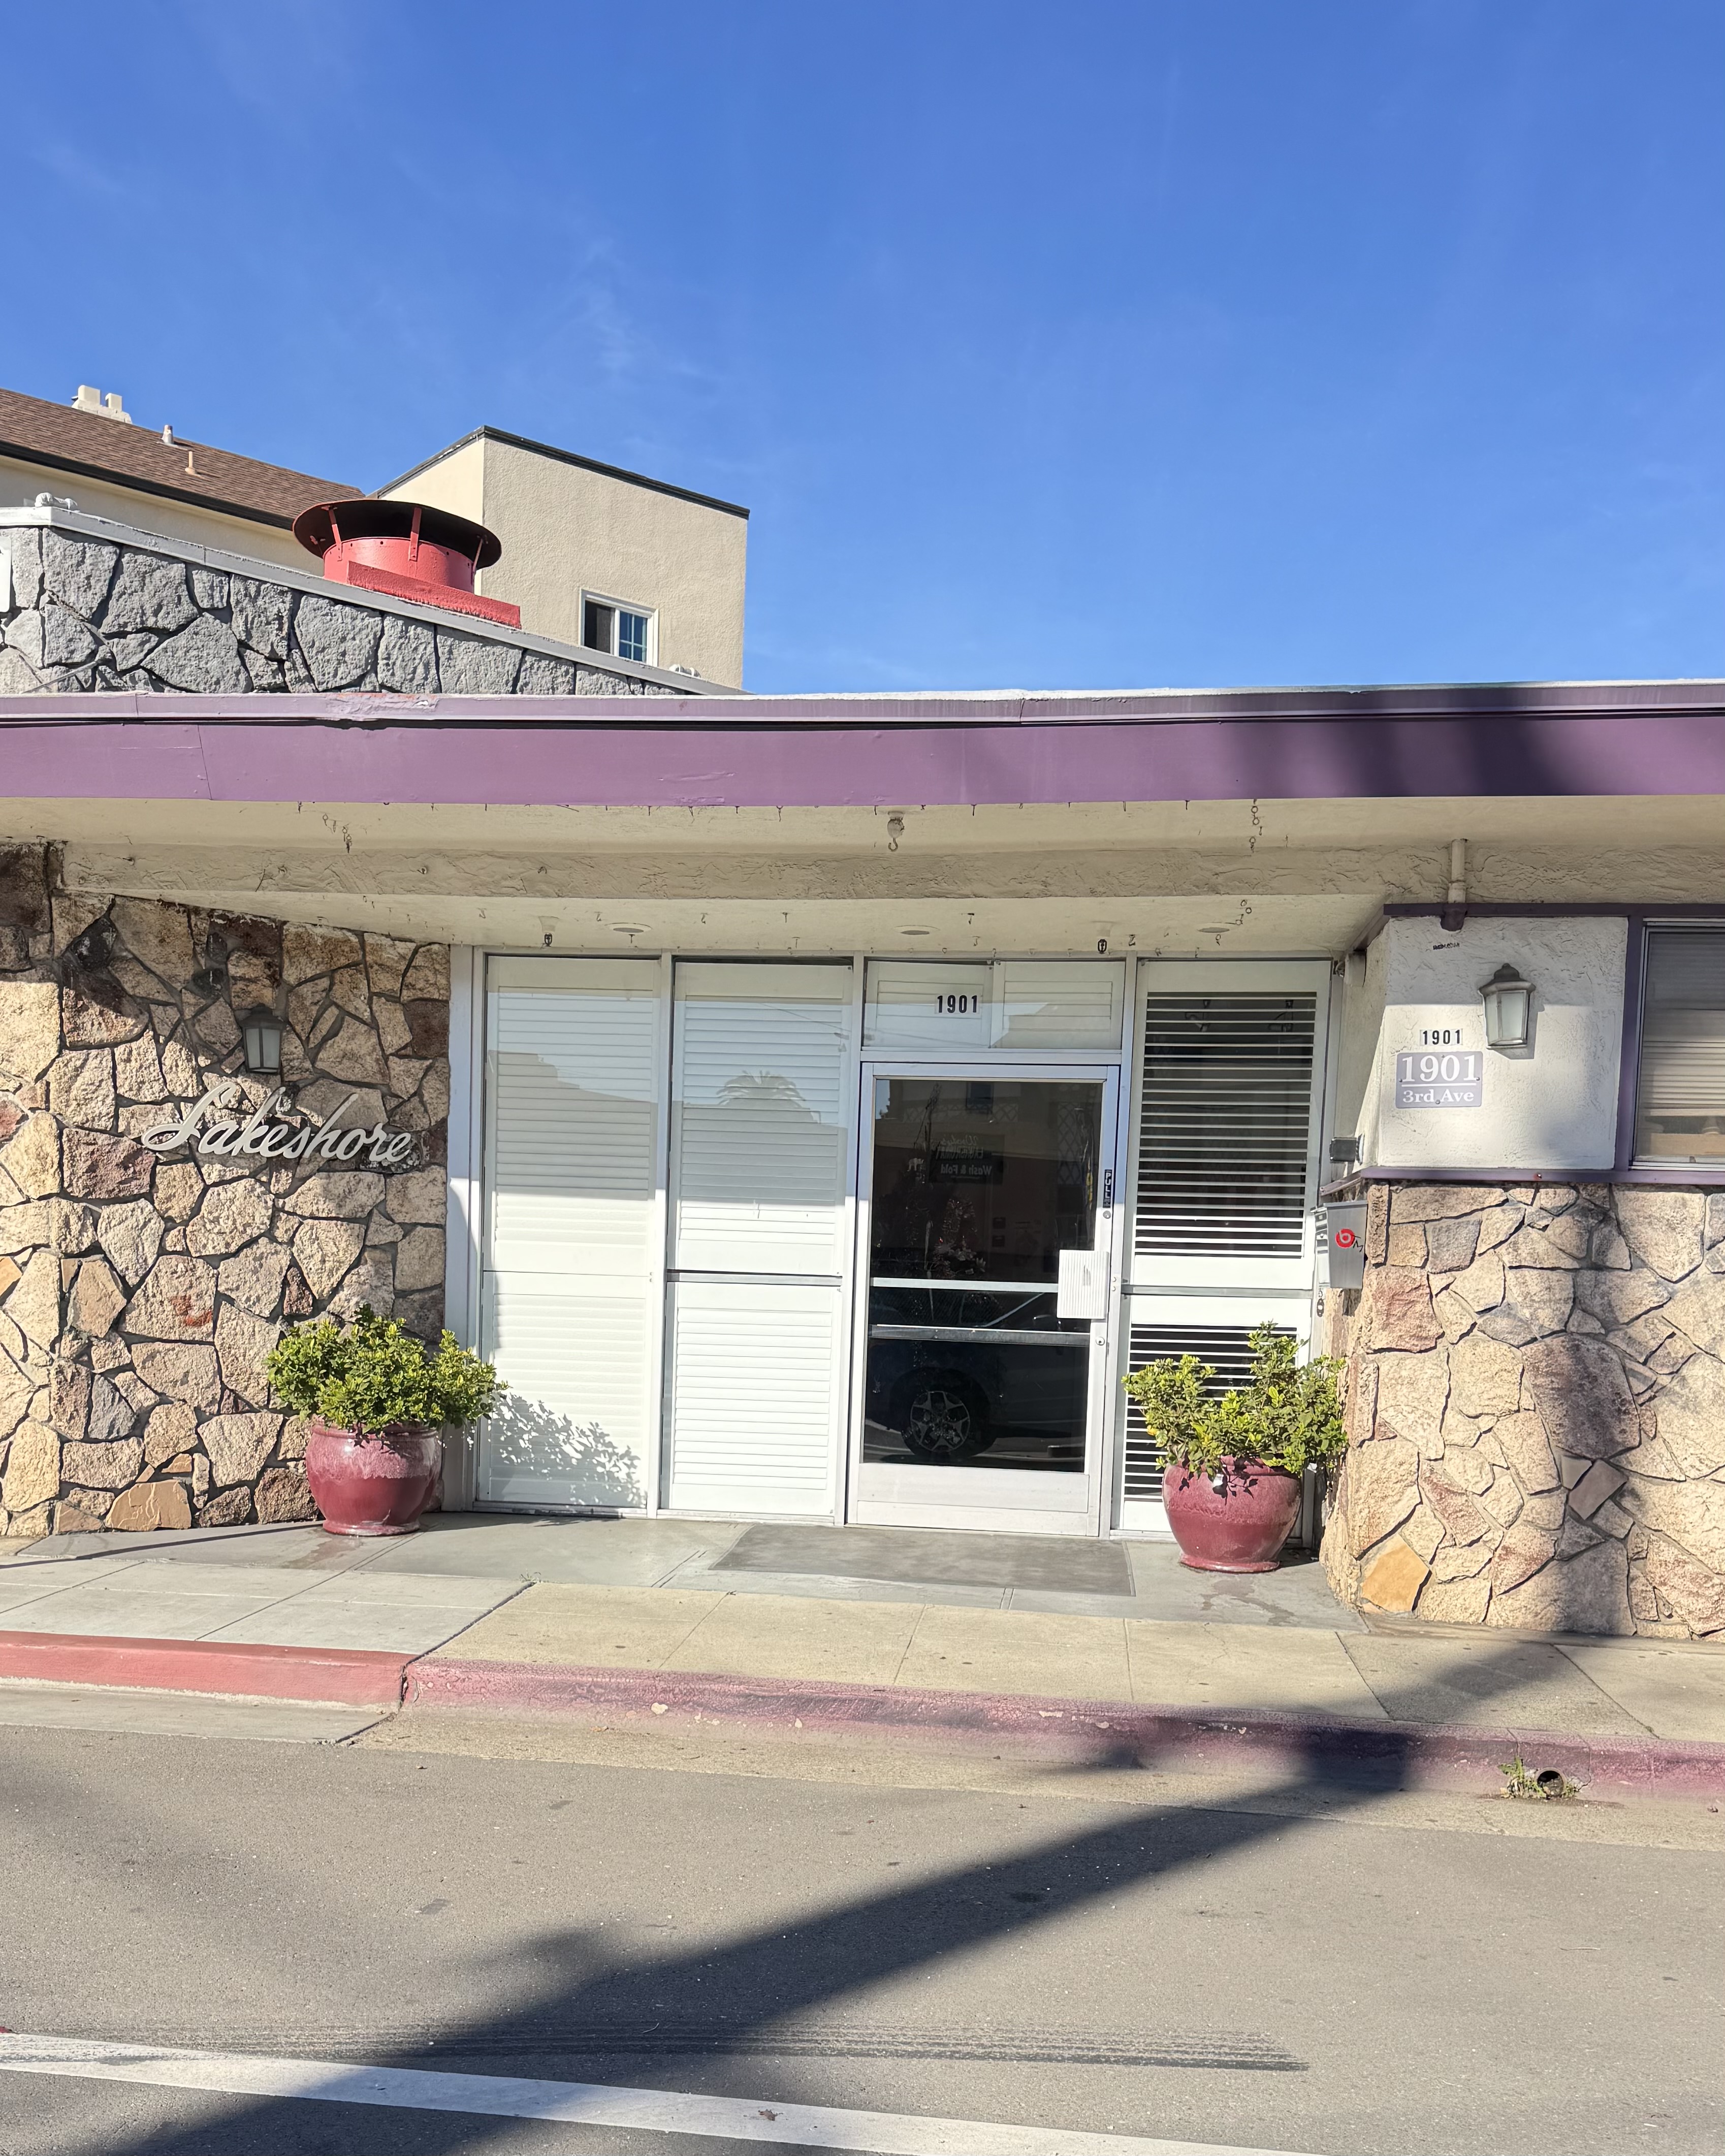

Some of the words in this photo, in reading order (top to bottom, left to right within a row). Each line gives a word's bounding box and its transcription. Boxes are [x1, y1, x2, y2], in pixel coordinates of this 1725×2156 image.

[937, 994, 977, 1014] 1901
[1423, 1029, 1460, 1045] 1901
[1402, 1054, 1477, 1082] 1901
[1402, 1089, 1434, 1103] 3rd
[1440, 1088, 1474, 1102] Ave
[141, 1081, 411, 1162] Lakeshore
